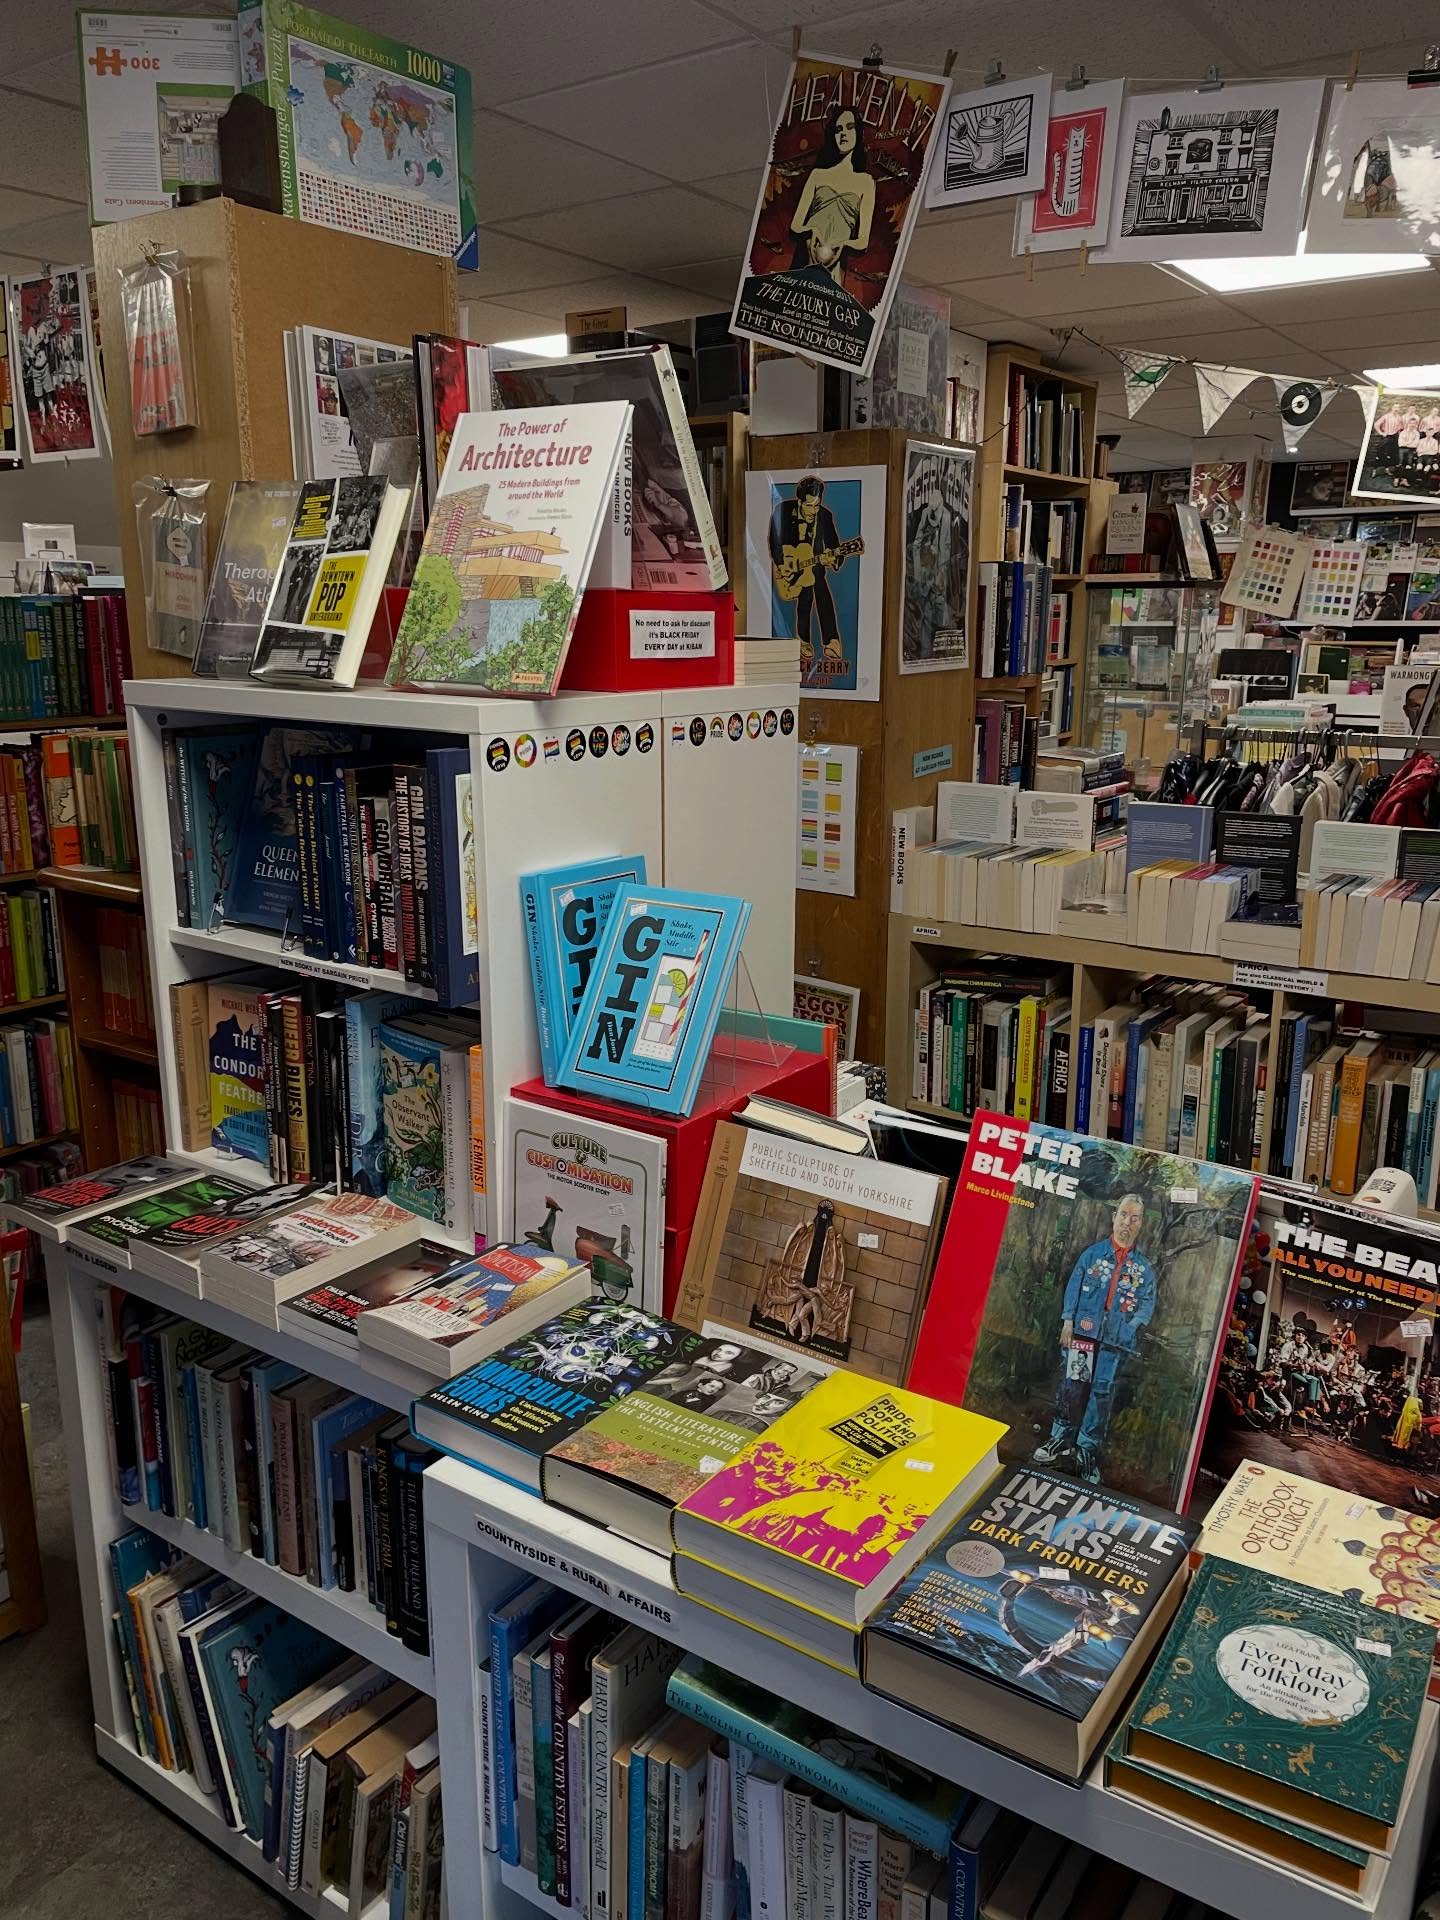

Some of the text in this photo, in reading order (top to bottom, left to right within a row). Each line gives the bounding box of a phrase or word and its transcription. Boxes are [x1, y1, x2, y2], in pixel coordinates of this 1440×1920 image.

[131, 57, 160, 71] 300
[271, 28, 284, 83] Puzzle
[334, 37, 347, 50] OF
[369, 48, 398, 68] EARTH
[406, 50, 441, 83] 1000
[786, 70, 936, 151] HEAVEN 17
[277, 103, 295, 218] Ravensburger
[756, 282, 785, 302] THE
[784, 290, 832, 318] LUXURY
[835, 304, 860, 326] GAP
[740, 309, 768, 328] THE
[770, 319, 865, 359] ROUNDHOUSE
[499, 418, 568, 437] The Power of
[458, 443, 593, 472] Architecture
[499, 478, 581, 491] 25 Modern Buildings from
[508, 490, 564, 500] around the World
[623, 432, 633, 537] NEW BOOKS
[321, 571, 355, 582] DOWNTOWN
[328, 561, 337, 571] THE
[316, 582, 347, 611] POP
[636, 619, 643, 627] No
[645, 619, 661, 627] need
[662, 619, 669, 627] to
[670, 619, 681, 627] ask
[689, 619, 710, 628] discount
[660, 631, 681, 639] BLACK
[682, 631, 700, 639] FRIDAY
[645, 643, 662, 651] EVERY
[664, 643, 678, 651] DAY
[816, 660, 850, 675] BERRY
[710, 730, 724, 739] PRIDE
[394, 776, 412, 882] THE HISTORY OF IDEAS
[410, 785, 429, 891] GUN BARONS
[376, 818, 396, 917] GOMORRAH
[897, 851, 905, 885] BOOKS
[370, 902, 378, 940] CYNTHIA
[669, 929, 697, 941] Muddle,
[670, 919, 694, 931] Shake,
[916, 927, 938, 936] AFRICA
[664, 938, 680, 948] Stir
[281, 959, 369, 985] NEW BOOKS AT BARGAIN PRICES
[1237, 961, 1269, 972] AFRICA
[233, 1033, 257, 1051] THE
[214, 1055, 264, 1080] CONDOR
[282, 1004, 302, 1118] QUEER BLUES
[1055, 1050, 1069, 1094] AFRICA
[391, 1099, 430, 1122] Observant
[403, 1094, 415, 1105] The
[1253, 1090, 1267, 1145] NELSON MANDELA
[1299, 1101, 1309, 1128] Mandela
[397, 1112, 424, 1132] Walker
[552, 1132, 608, 1164] CULTURE
[574, 1150, 588, 1164] &
[751, 1142, 856, 1179] PUBLIC SCULPTURE OF
[979, 1121, 1083, 1168] PETER
[472, 1137, 485, 1190] FEMINIST
[526, 1148, 635, 1195] CUSTOMISATION
[971, 1151, 1080, 1200] BLAKE
[547, 1172, 610, 1196] THE MOTOR SCOOTER STORY
[749, 1155, 914, 1211] SHEFFIELD AND SOUTH YORKSHIRE
[966, 1181, 1035, 1209] Marco Livingstone
[289, 1211, 361, 1241] amsterdam
[1274, 1219, 1348, 1260] THE
[1270, 1248, 1435, 1305] ALL YOU NEED
[1070, 1340, 1095, 1352] ELVIS
[430, 1392, 490, 1420] HELEN KING
[440, 1375, 514, 1414] FORMS
[466, 1358, 596, 1419] IMMACULATE
[615, 1404, 637, 1416] THE
[636, 1411, 697, 1439] SIXTEENTH
[624, 1397, 747, 1445] ENGLISH LITERATURE
[855, 1411, 911, 1447] POLITICS
[866, 1404, 917, 1440] POP AND
[878, 1398, 917, 1428] PRIDE,
[154, 1408, 164, 1464] SYNDROME
[1000, 1473, 1186, 1557] INFINITE
[1208, 1474, 1254, 1534] TIMOTHY WARE
[1238, 1498, 1263, 1518] THE
[1241, 1480, 1298, 1554] ORTHODOX
[981, 1496, 1114, 1561] STARS
[1269, 1498, 1314, 1552] CHURCH
[476, 1520, 672, 1625] COUNTRYSIDE & RURAL AFFAIRS
[968, 1519, 1150, 1596] DARK FRONTIERS
[1239, 1639, 1352, 1690] Everyday
[1240, 1659, 1339, 1704] Folklore
[554, 1651, 567, 1858] Tales from the COUNTRY ESTATES
[668, 1689, 850, 1797] THE ENGLISH COUNTRYWOMAN
[593, 1675, 608, 1870] HARDY COUNTRY Beningfield
[735, 1770, 748, 1831] Rural Life
